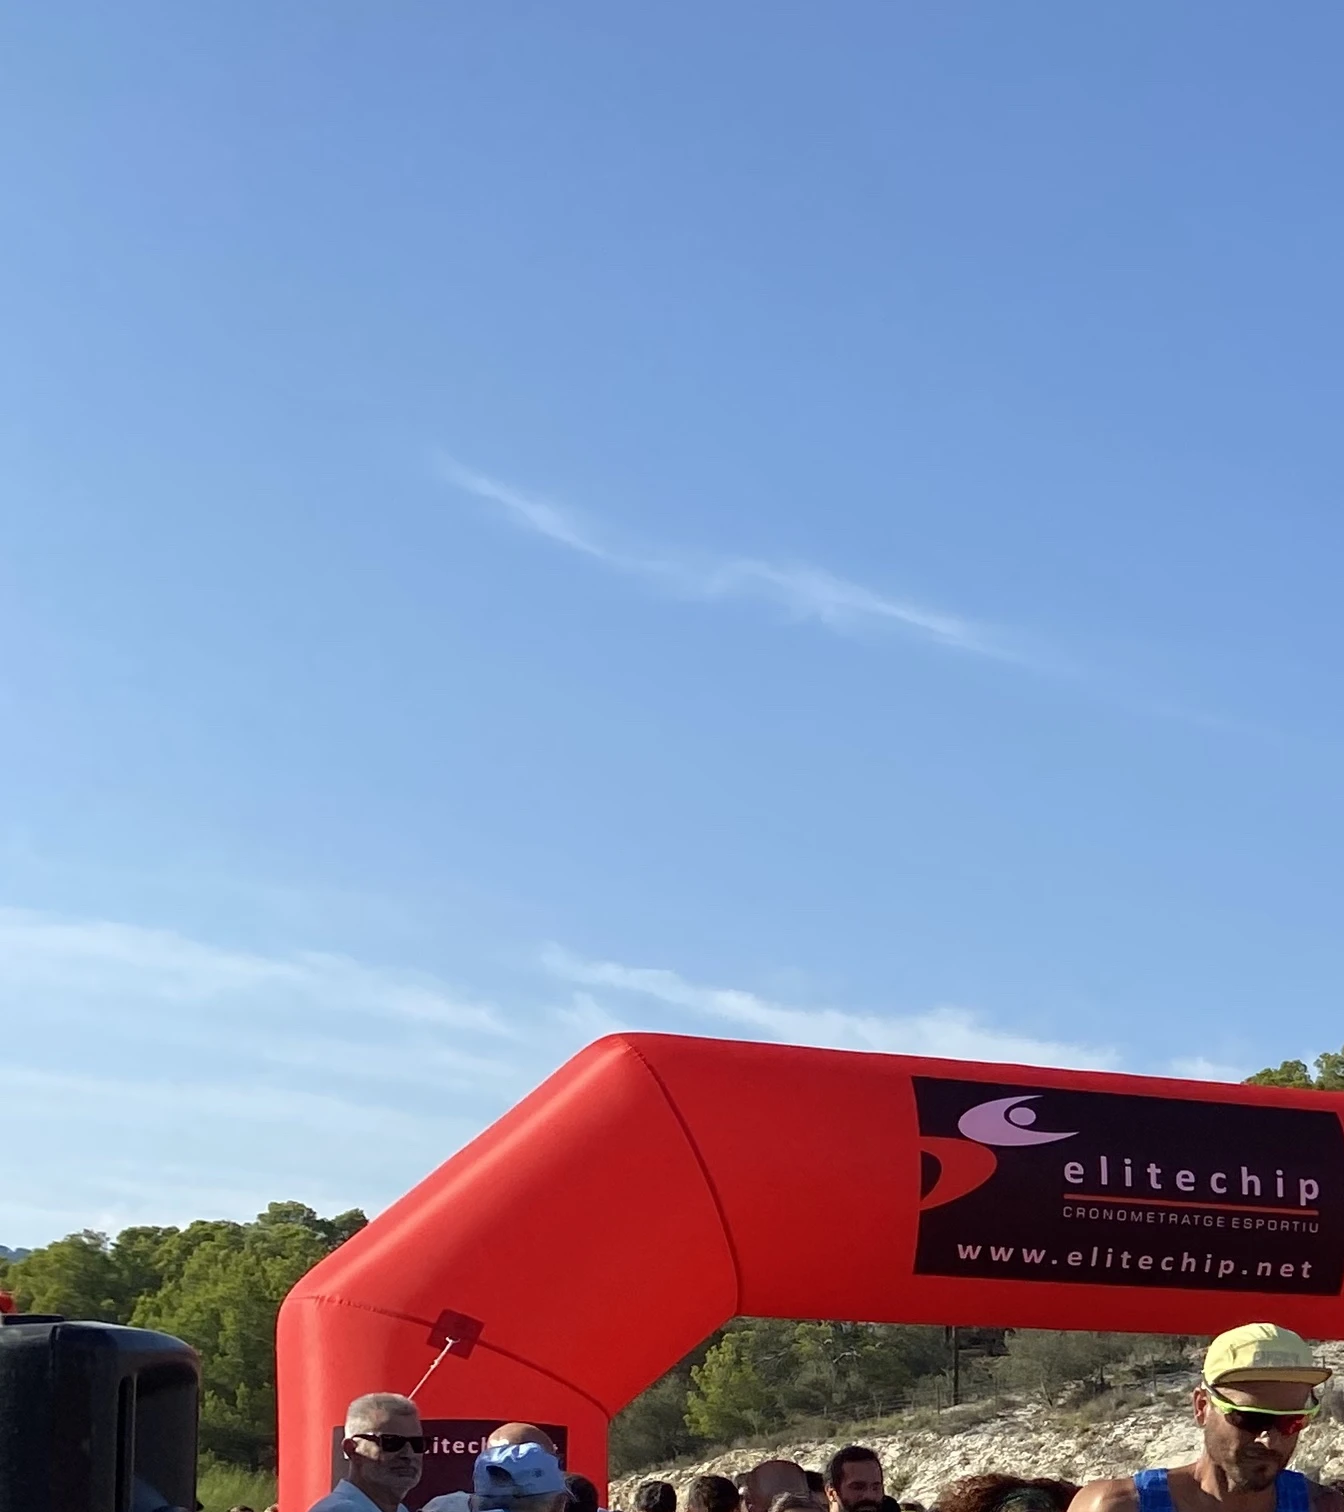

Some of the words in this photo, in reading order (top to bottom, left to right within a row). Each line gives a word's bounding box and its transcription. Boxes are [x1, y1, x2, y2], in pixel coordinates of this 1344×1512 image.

[1063, 1155, 1321, 1206] elitechip
[1063, 1205, 1226, 1229] CRONOMETRATGE
[1231, 1217, 1319, 1234] ESPORTIU
[957, 1242, 1313, 1279] www.elitechip.net
